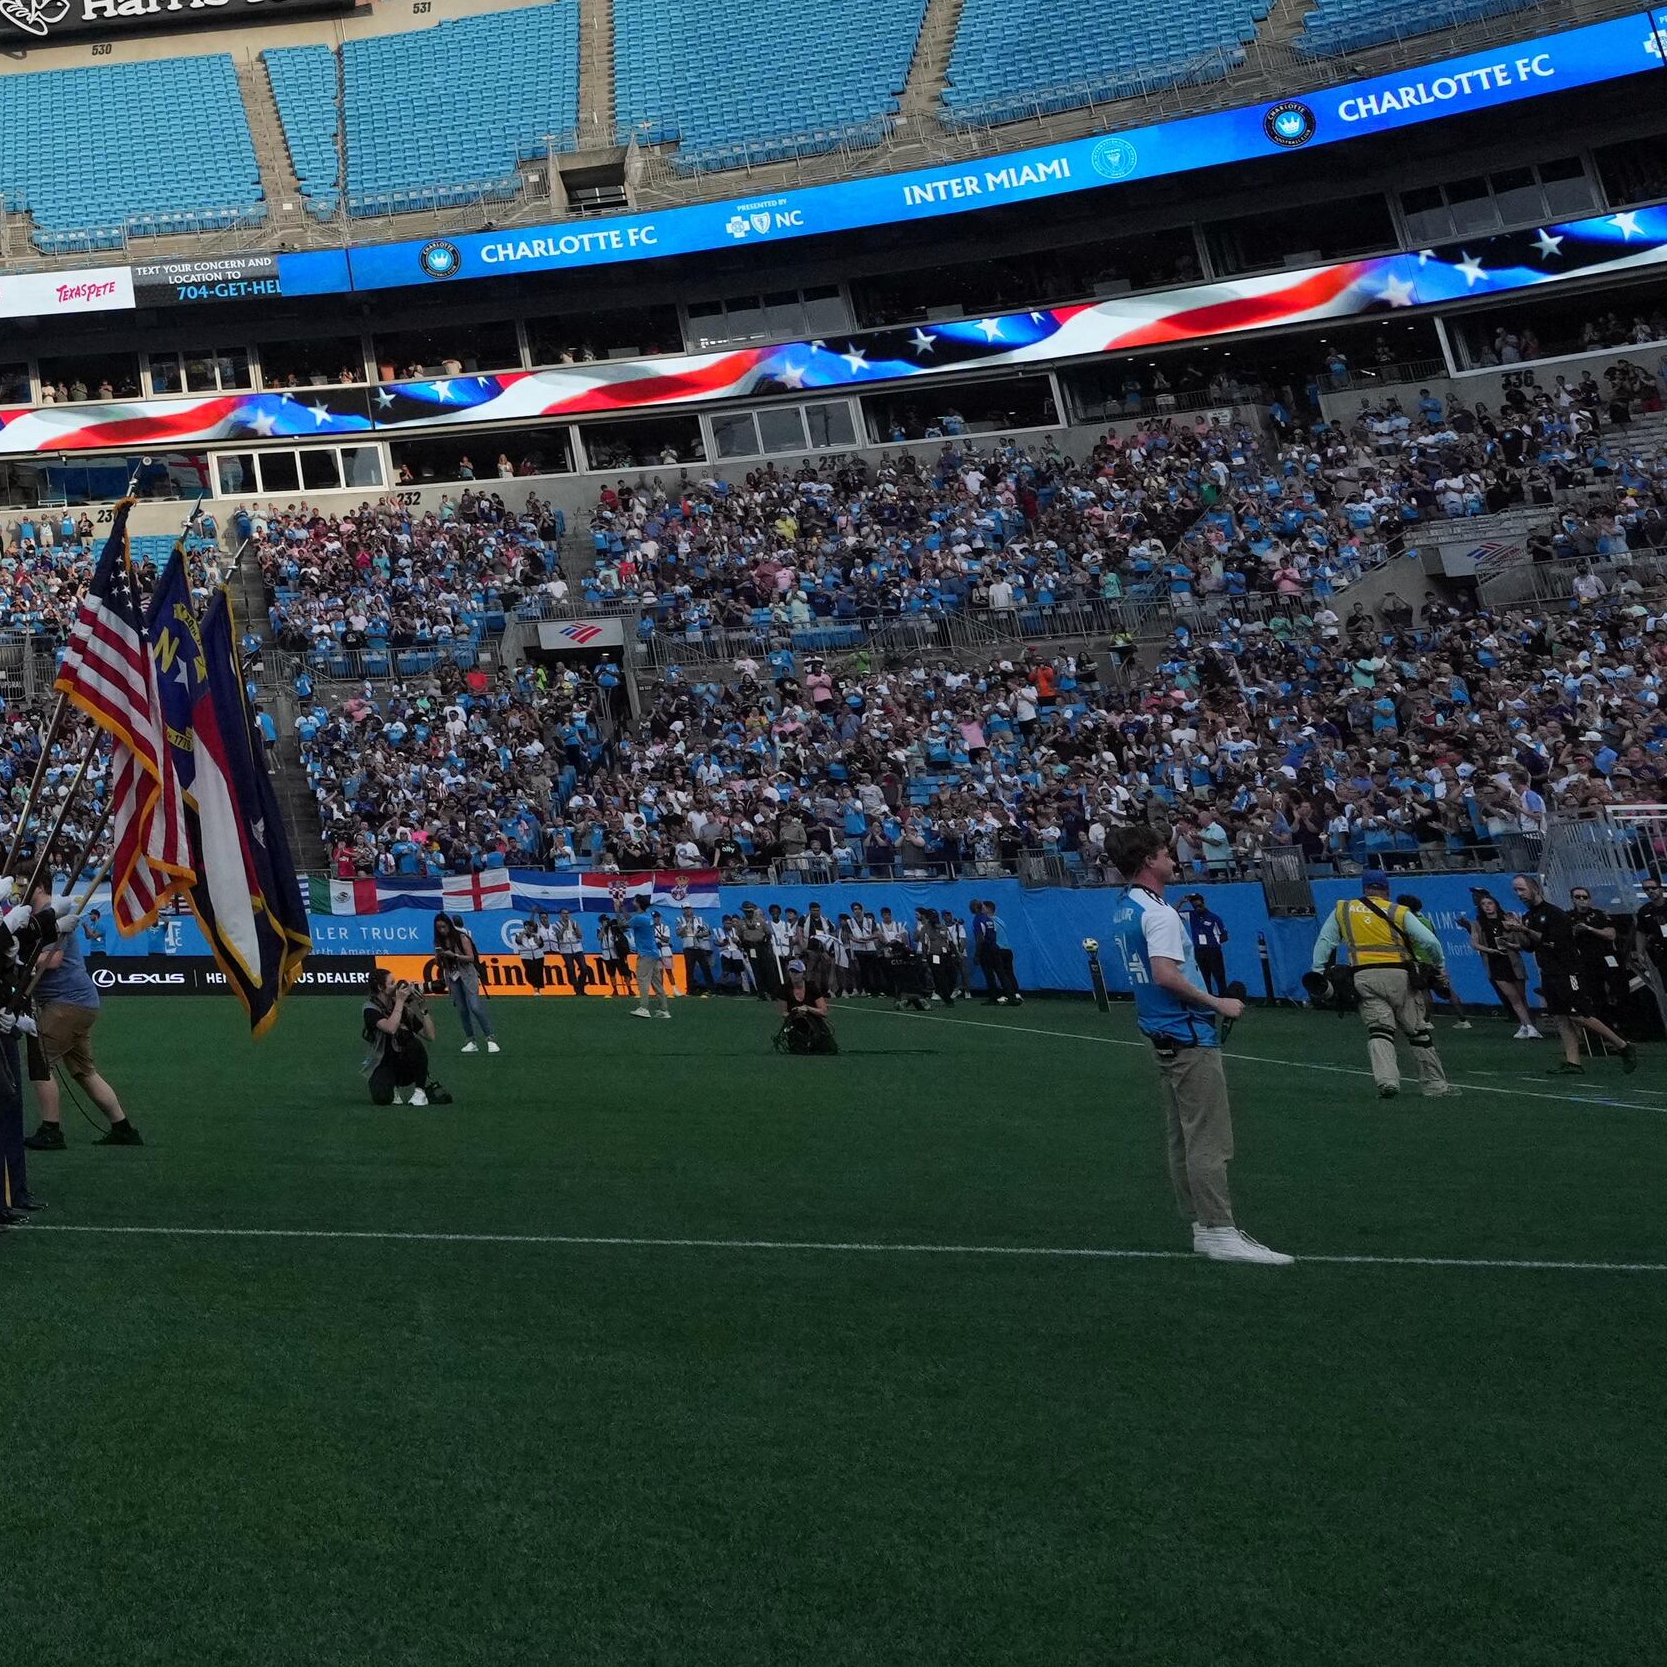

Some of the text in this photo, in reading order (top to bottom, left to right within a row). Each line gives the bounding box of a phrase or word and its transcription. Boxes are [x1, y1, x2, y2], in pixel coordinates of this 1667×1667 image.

[412, 2, 431, 14] 531
[91, 44, 112, 55] 530
[1338, 54, 1555, 121] CHARLOTTE FC
[903, 176, 982, 205] INTER
[985, 158, 1071, 191] MIAMI
[775, 210, 804, 228] NC
[481, 225, 658, 264] CHARLOTTE FC
[135, 257, 272, 276] TEXT YOUR CONCERN AND
[168, 271, 241, 285] LOCATION TO
[97, 510, 112, 522] 23
[360, 927, 419, 940] TRUCK
[117, 971, 185, 984] LEXUS
